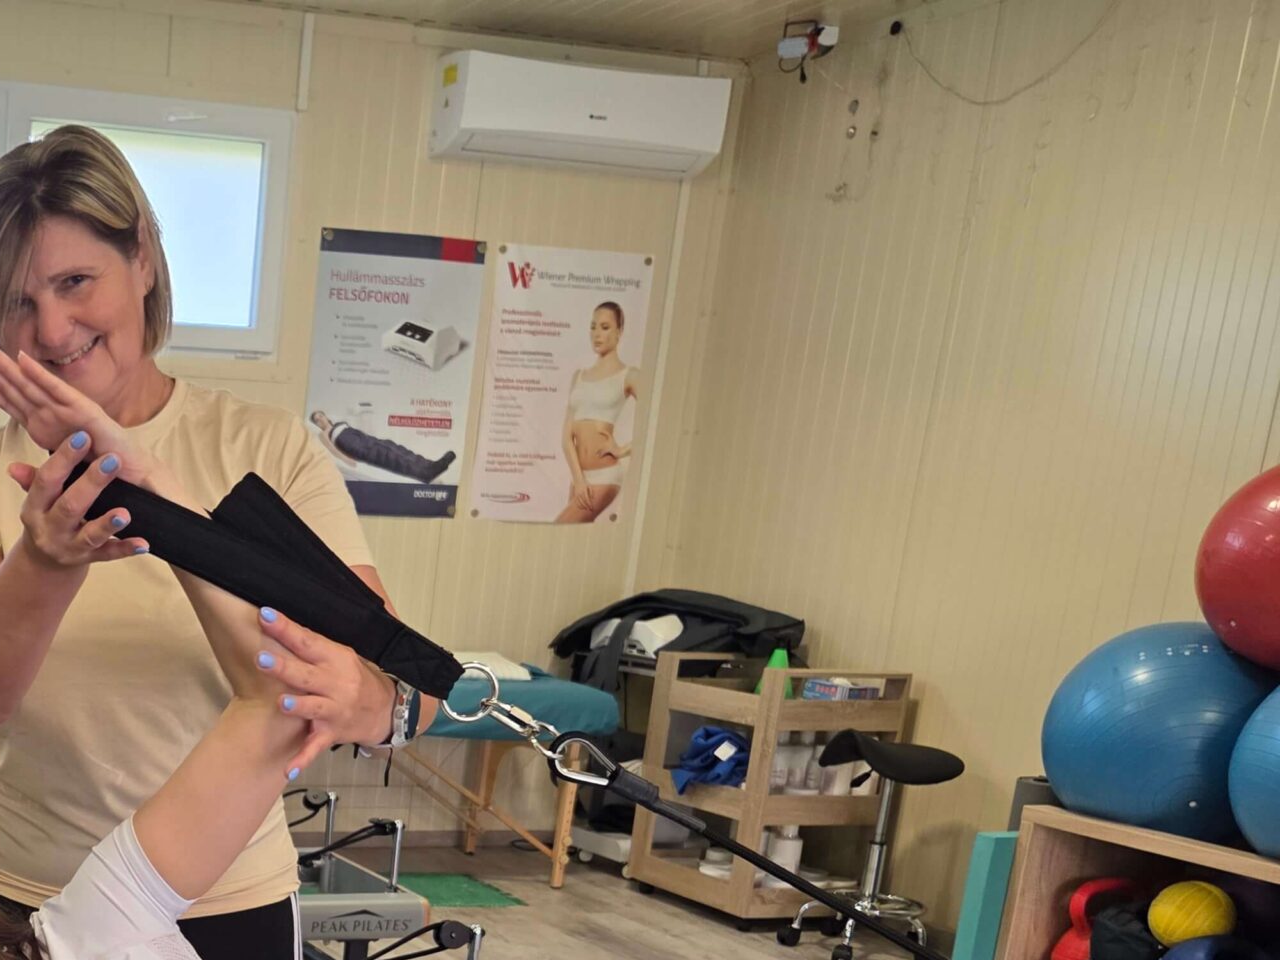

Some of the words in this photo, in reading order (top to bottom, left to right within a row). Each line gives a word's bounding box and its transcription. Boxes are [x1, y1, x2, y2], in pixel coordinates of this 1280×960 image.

[330, 268, 425, 288] Hullámmasszázs
[538, 271, 566, 281] Wiener
[568, 272, 602, 285] Premium
[604, 275, 641, 289] Wrapping
[328, 286, 409, 305] FELSŐFOKON
[311, 920, 349, 933] PEAK
[352, 919, 410, 932] PILATES
